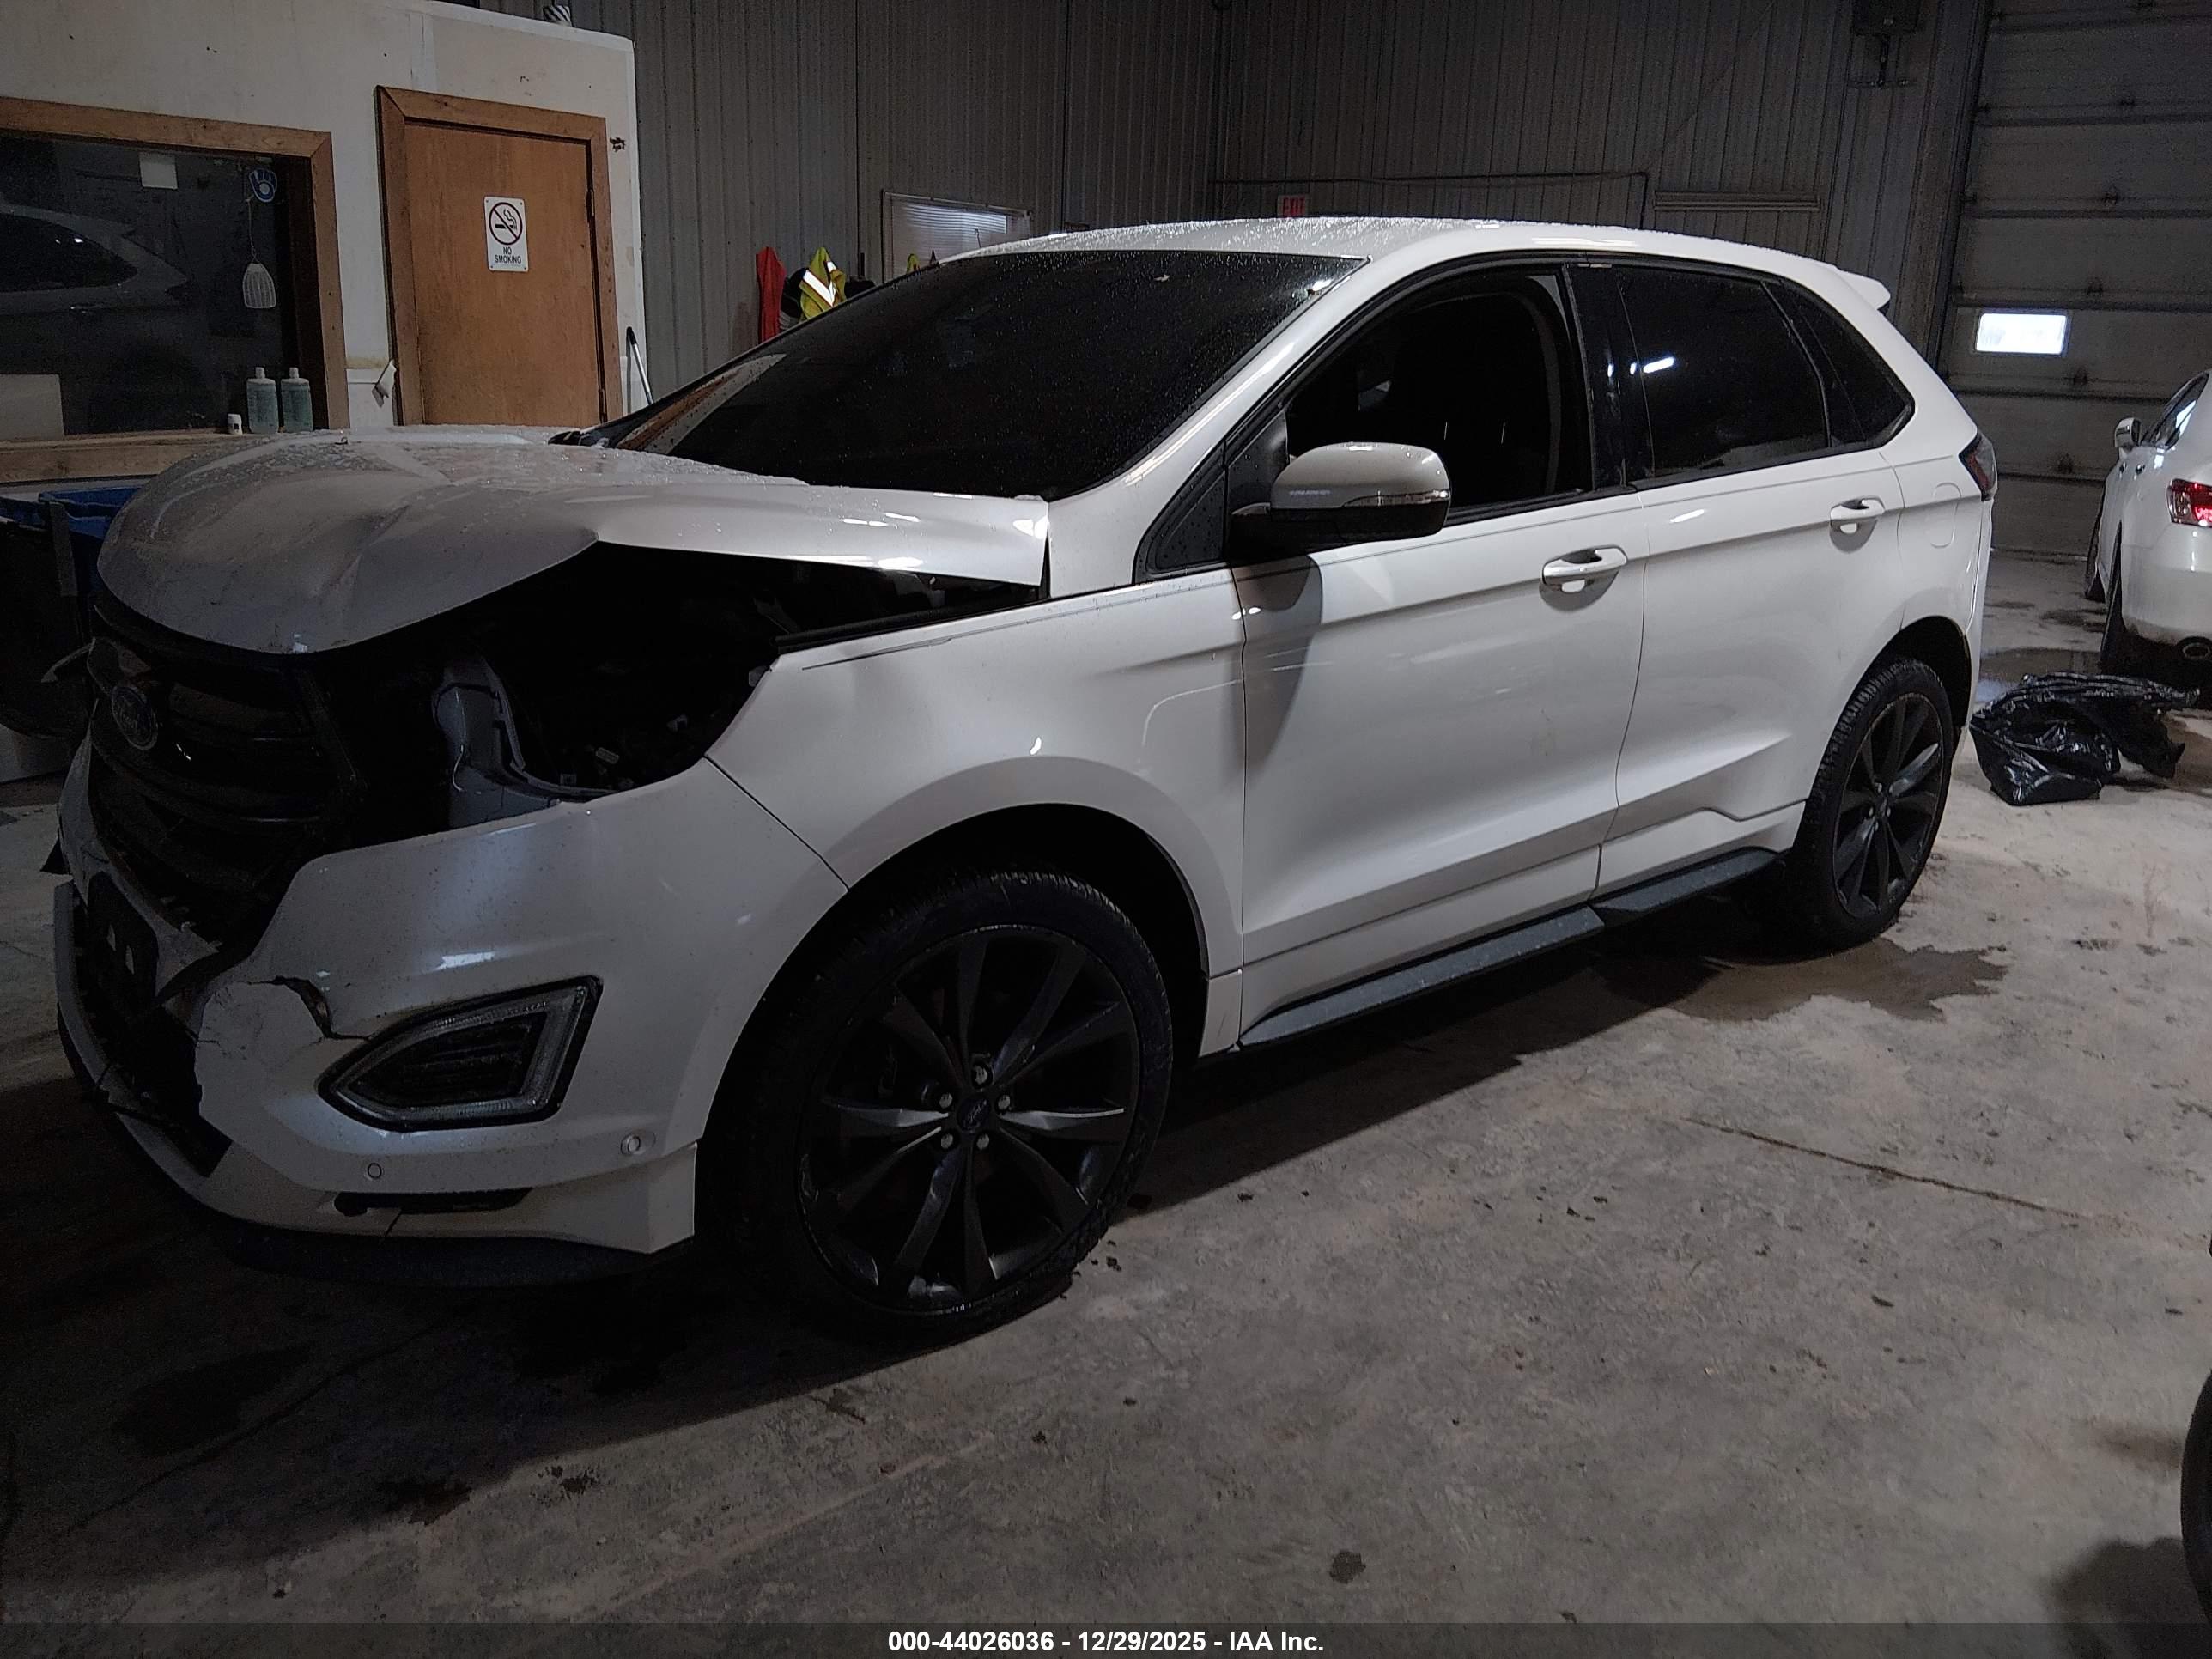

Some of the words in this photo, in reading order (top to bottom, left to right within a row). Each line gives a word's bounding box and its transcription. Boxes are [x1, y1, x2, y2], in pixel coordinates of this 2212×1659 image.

[1283, 198, 1304, 216] EXIT
[503, 246, 513, 255] NO
[495, 254, 522, 264] SMOKING
